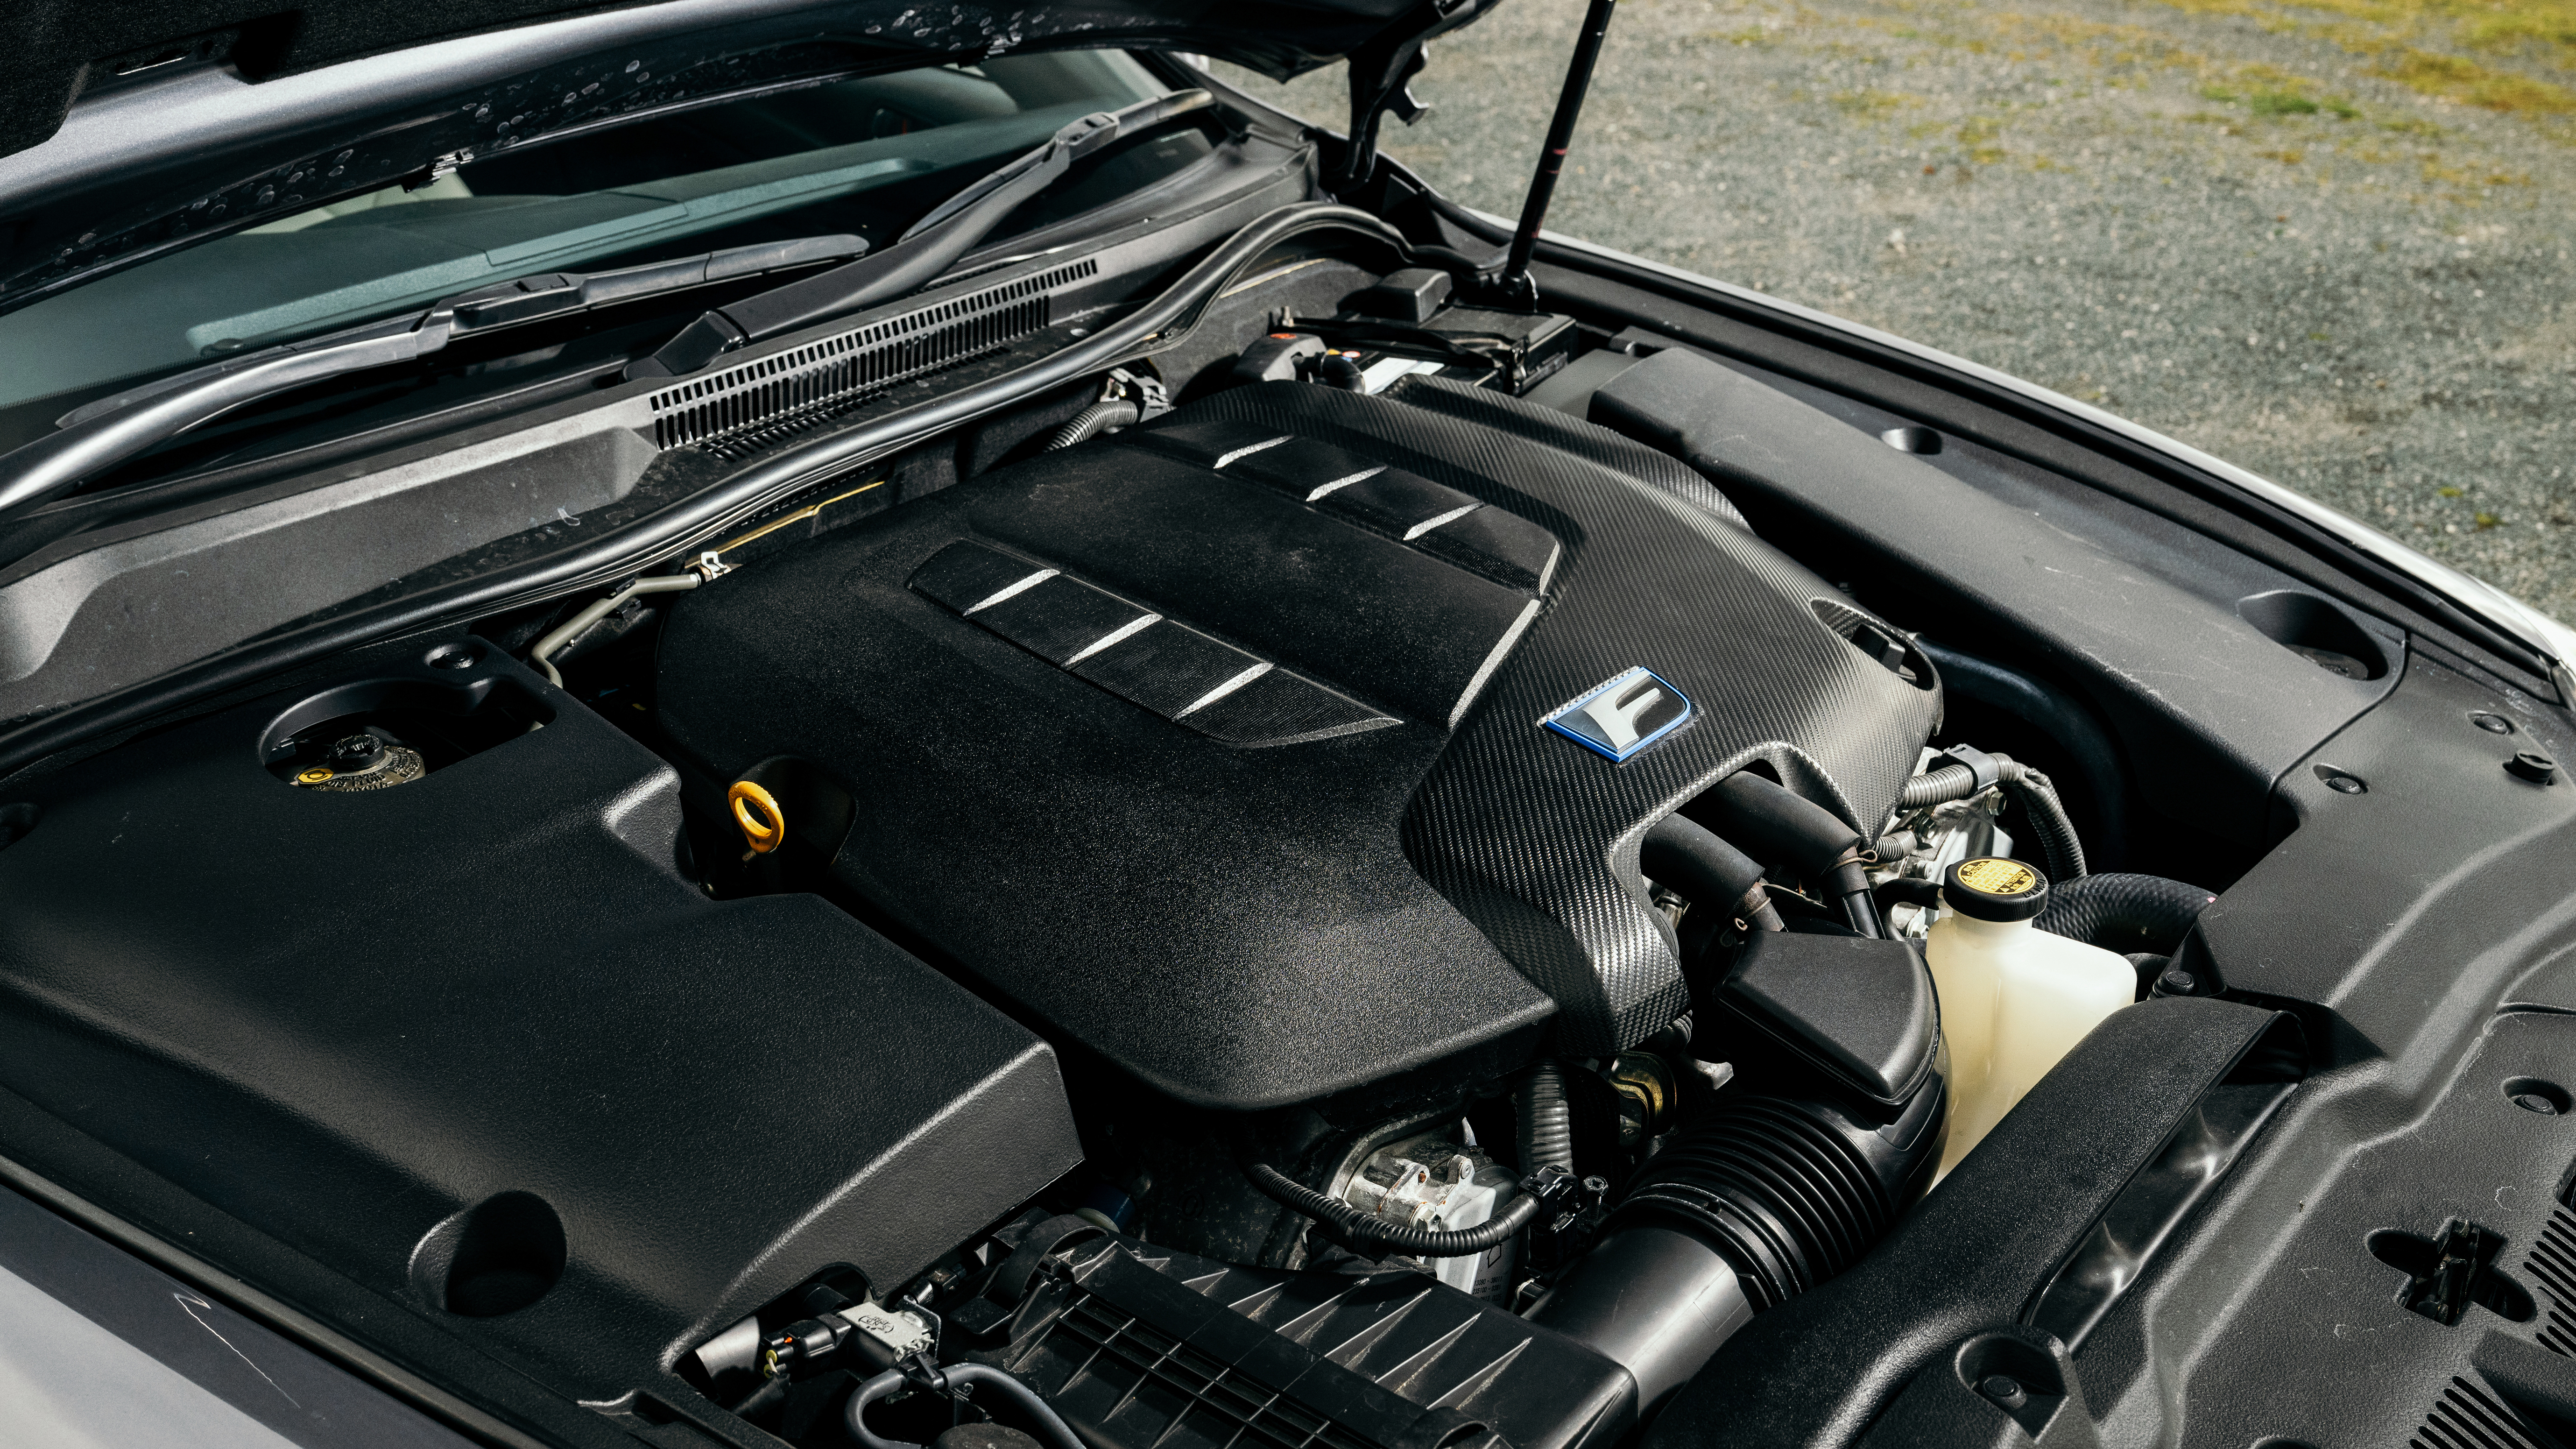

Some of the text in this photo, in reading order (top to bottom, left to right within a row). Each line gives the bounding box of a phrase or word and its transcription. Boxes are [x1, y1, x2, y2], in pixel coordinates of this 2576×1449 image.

[1966, 861, 1987, 876] CAUTION
[2003, 871, 2027, 887] ATTENTION
[2022, 878, 2047, 898] DENSO
